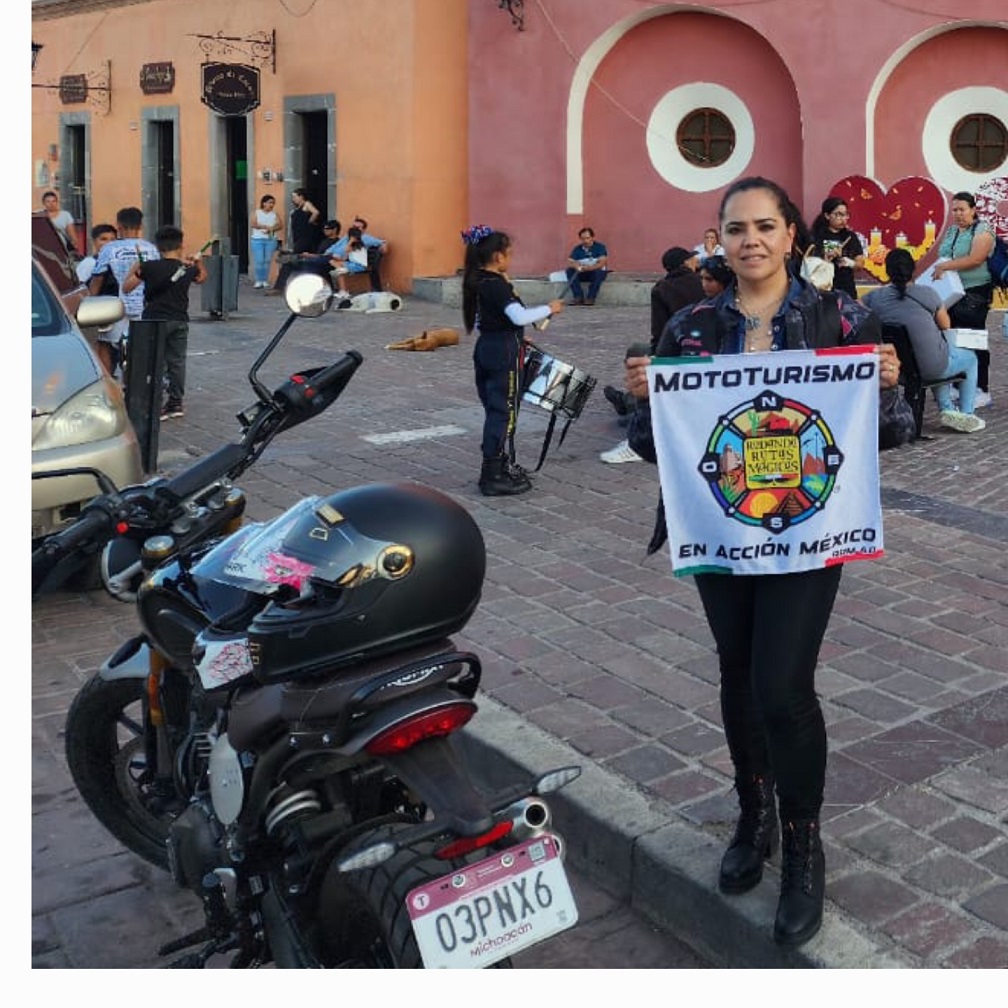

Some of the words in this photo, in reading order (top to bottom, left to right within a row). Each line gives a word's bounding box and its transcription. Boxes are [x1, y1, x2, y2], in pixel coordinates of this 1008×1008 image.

[654, 361, 876, 393] MOTOTURISMO
[679, 543, 707, 558] EN
[715, 537, 790, 561] ACCIÓN
[800, 528, 876, 556] MÉXICO
[436, 871, 553, 953] 03PNX6
